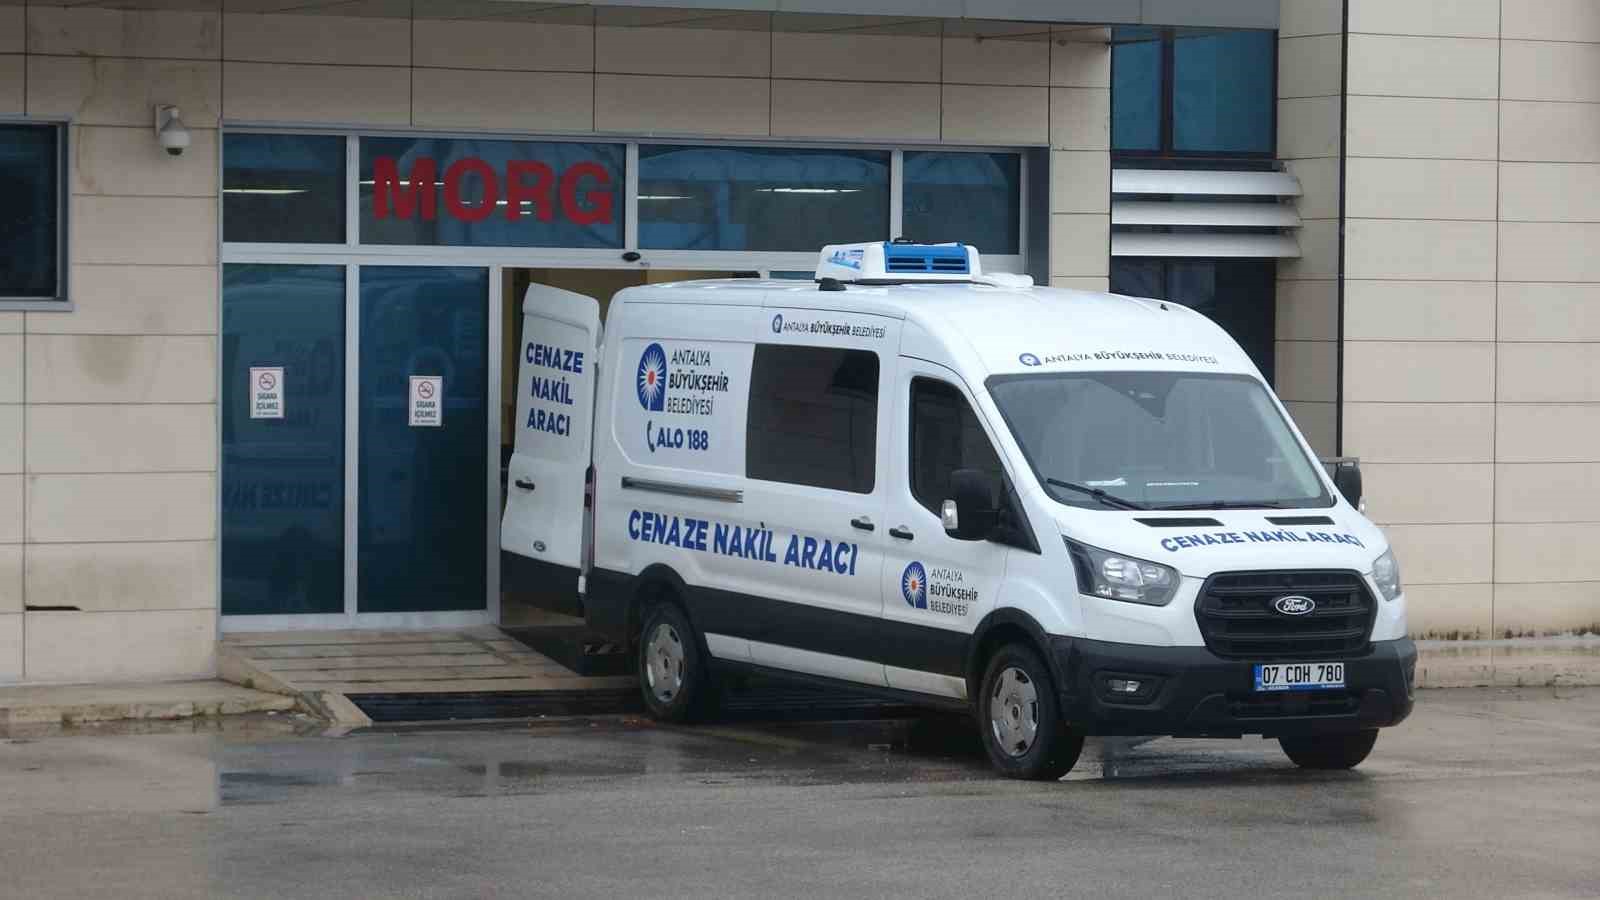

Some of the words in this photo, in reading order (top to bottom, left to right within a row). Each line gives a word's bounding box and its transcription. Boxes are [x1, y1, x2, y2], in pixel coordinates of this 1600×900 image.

[373, 156, 614, 225] MORG
[784, 321, 809, 333] ANTALYA
[526, 342, 584, 374] CENAZE
[671, 350, 711, 367] ANTALYA
[1045, 353, 1091, 364] ANTALYA
[531, 376, 574, 406] NAKİL
[669, 368, 729, 395] BÜYÜKŞEHİR
[667, 395, 714, 416] BELEDİYESİ
[527, 408, 571, 437] ARACI
[656, 427, 684, 449] ALO
[687, 429, 709, 451] 188
[628, 509, 708, 552] CENAZE
[713, 522, 777, 563] NAKİL
[783, 533, 859, 577] ARACI
[1161, 532, 1246, 552] CENAZE
[1242, 528, 1308, 543] NAKİL
[1306, 531, 1366, 549] ARACI
[931, 568, 963, 582] ANTALYA
[1283, 599, 1308, 612] Ford
[1263, 666, 1279, 684] 07
[1286, 665, 1311, 683] CDH
[1318, 664, 1342, 682] 780
